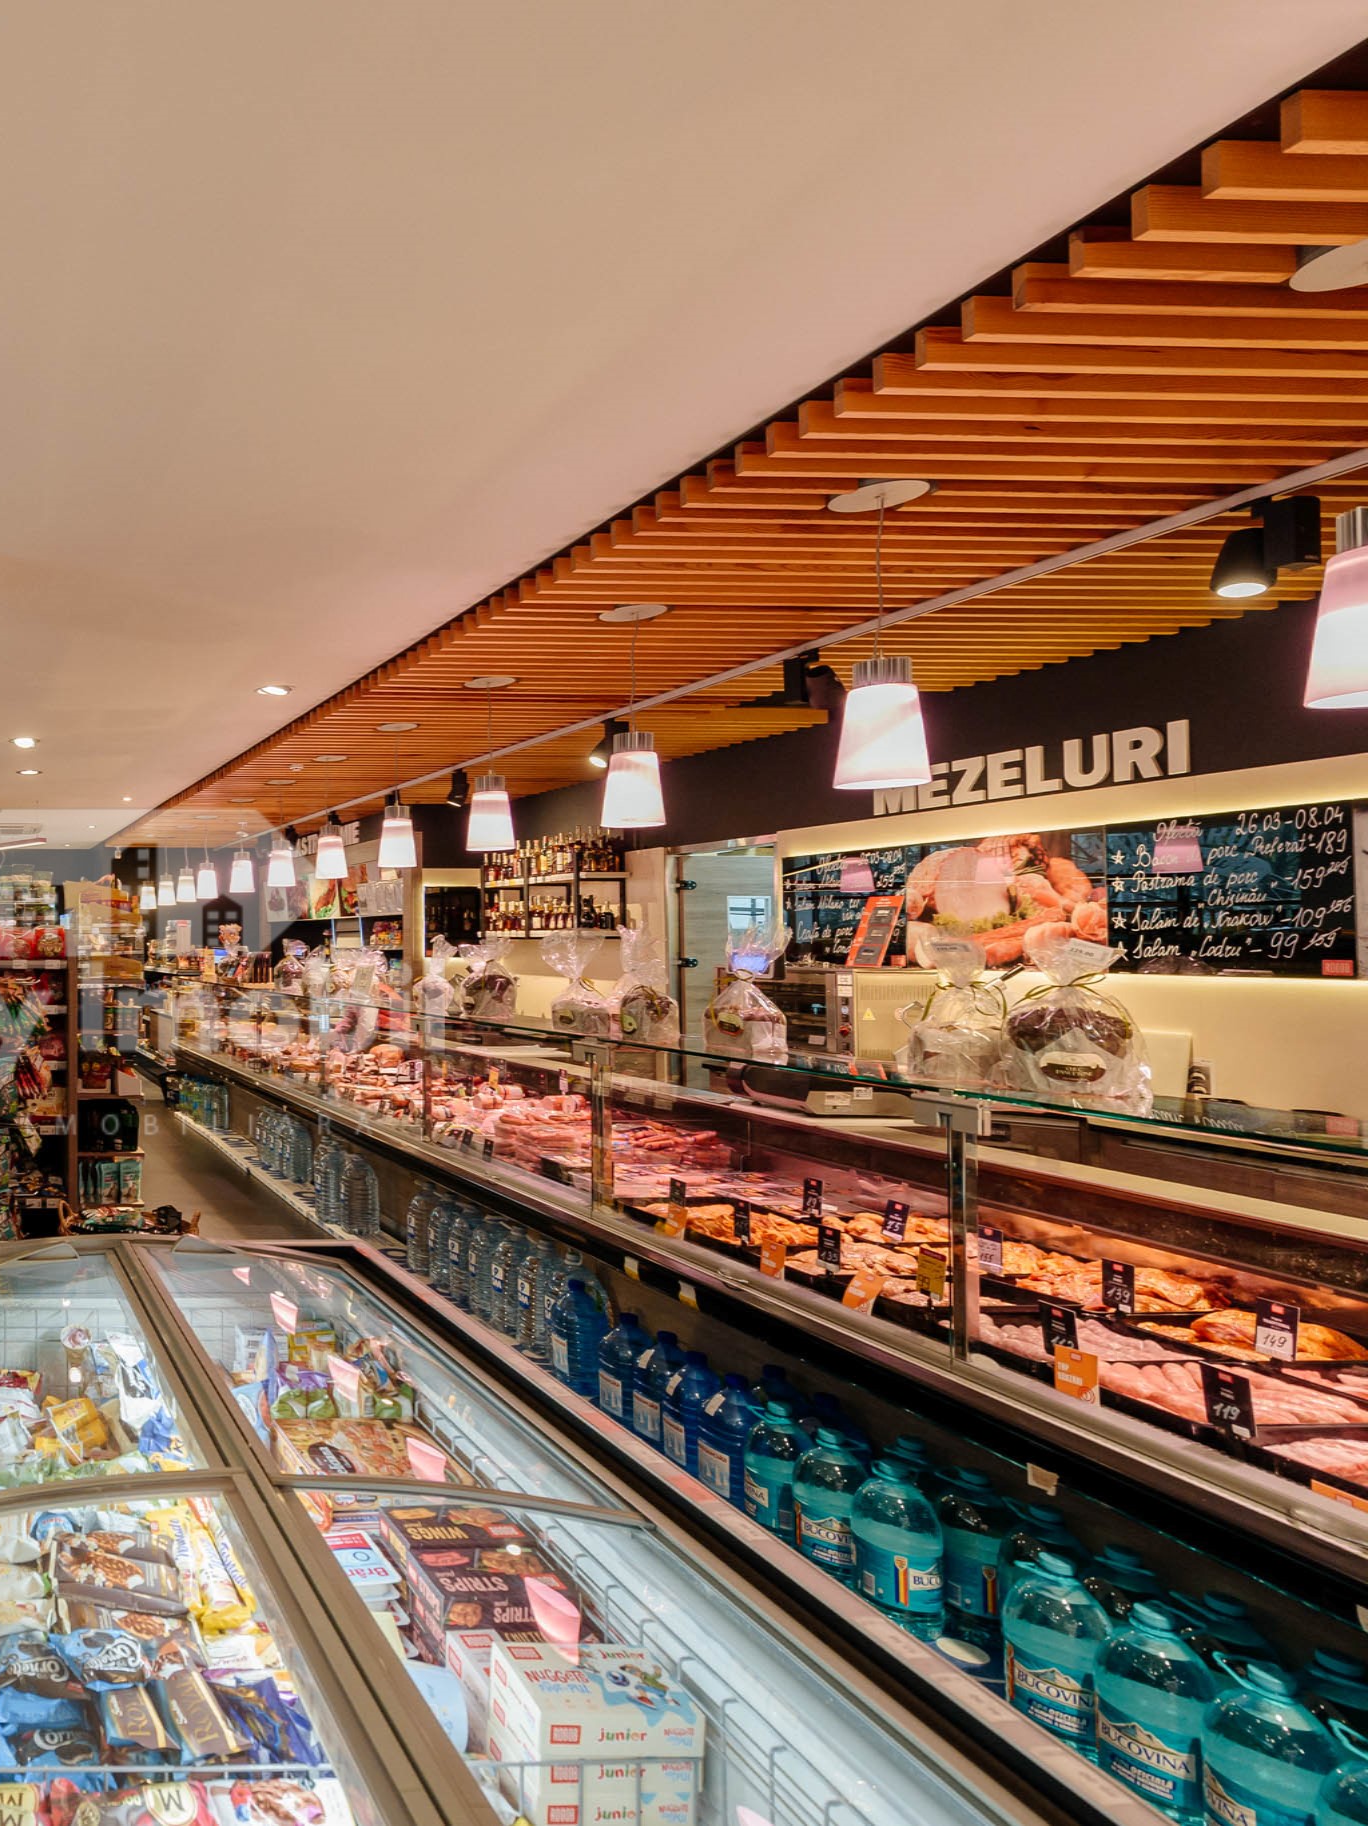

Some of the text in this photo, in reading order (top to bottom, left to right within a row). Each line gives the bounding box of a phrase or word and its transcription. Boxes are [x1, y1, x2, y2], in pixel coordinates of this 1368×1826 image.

[872, 718, 1192, 816] MEZELURI
[1131, 905, 1181, 932] Salam
[1132, 934, 1182, 959] Salam
[1106, 1287, 1131, 1303] 139
[1262, 1333, 1288, 1348] 149
[1212, 1402, 1241, 1420] 119
[408, 1525, 469, 1540] WINGS
[439, 1575, 509, 1592] STRIPS
[598, 1728, 647, 1743] junior
[1100, 1721, 1192, 1775] BUCOVINA
